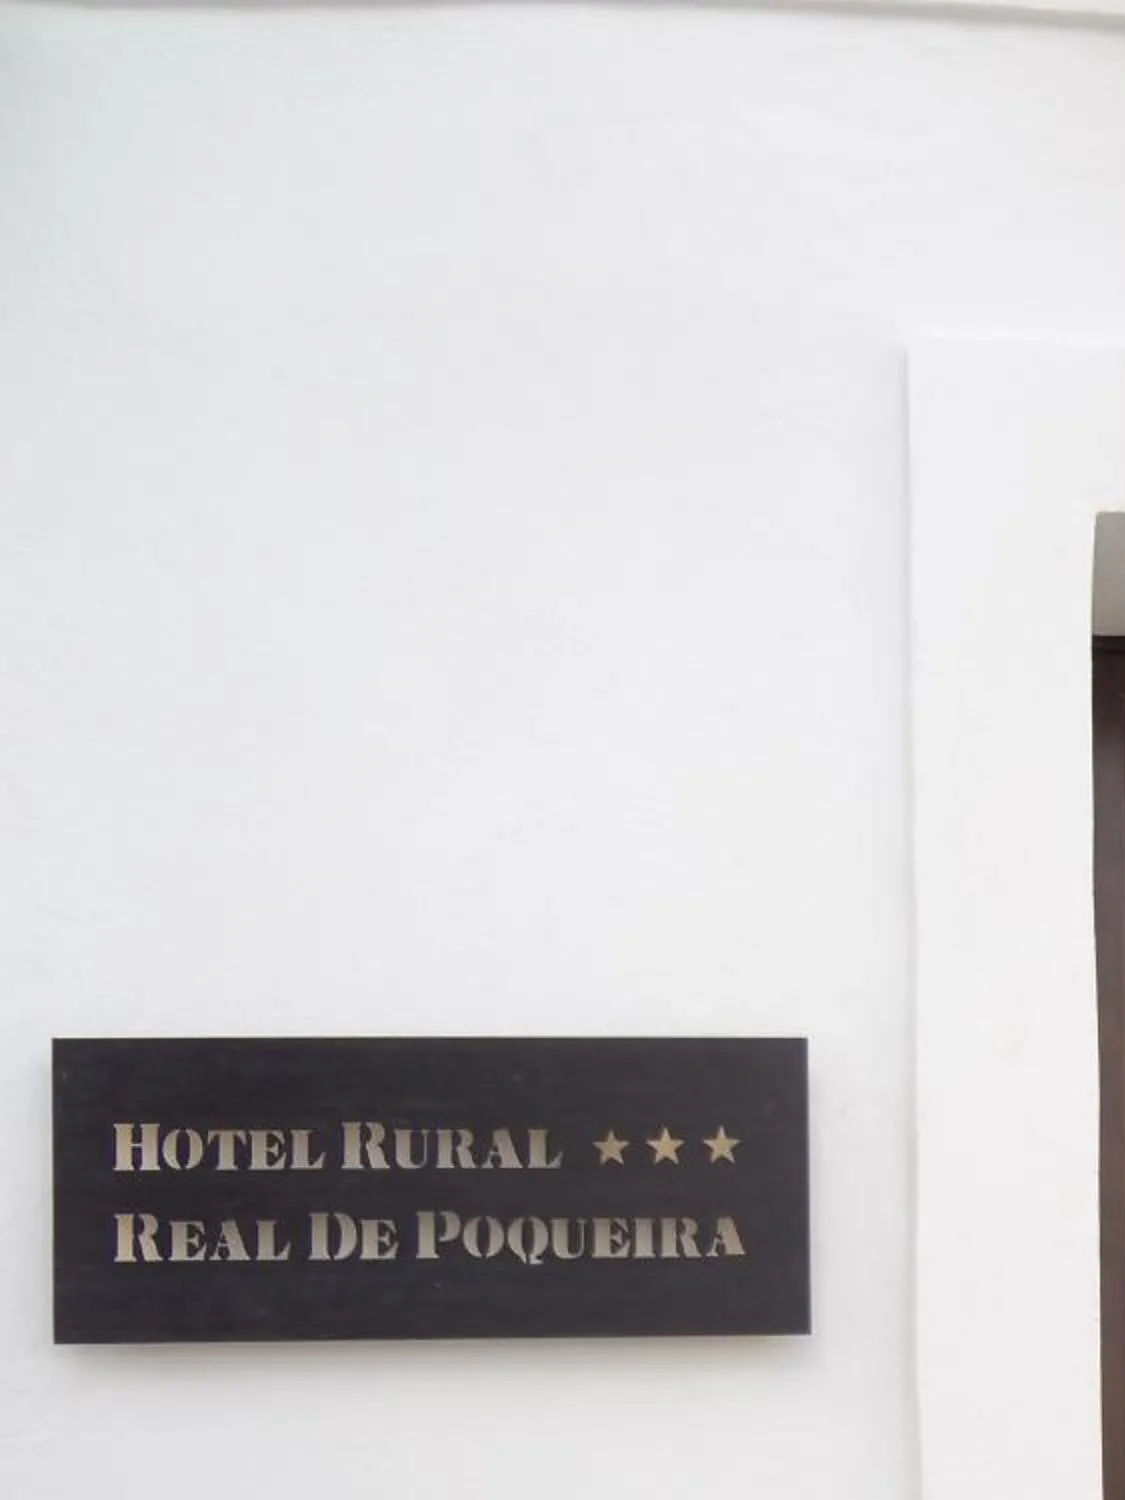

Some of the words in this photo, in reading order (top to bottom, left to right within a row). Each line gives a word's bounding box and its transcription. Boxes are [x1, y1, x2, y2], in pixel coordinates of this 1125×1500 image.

[112, 1122, 325, 1172] HOTEL
[341, 1121, 563, 1171] RURAL
[113, 1213, 291, 1263] REAL
[307, 1212, 399, 1262] DE
[415, 1210, 747, 1266] POQUEIRA
